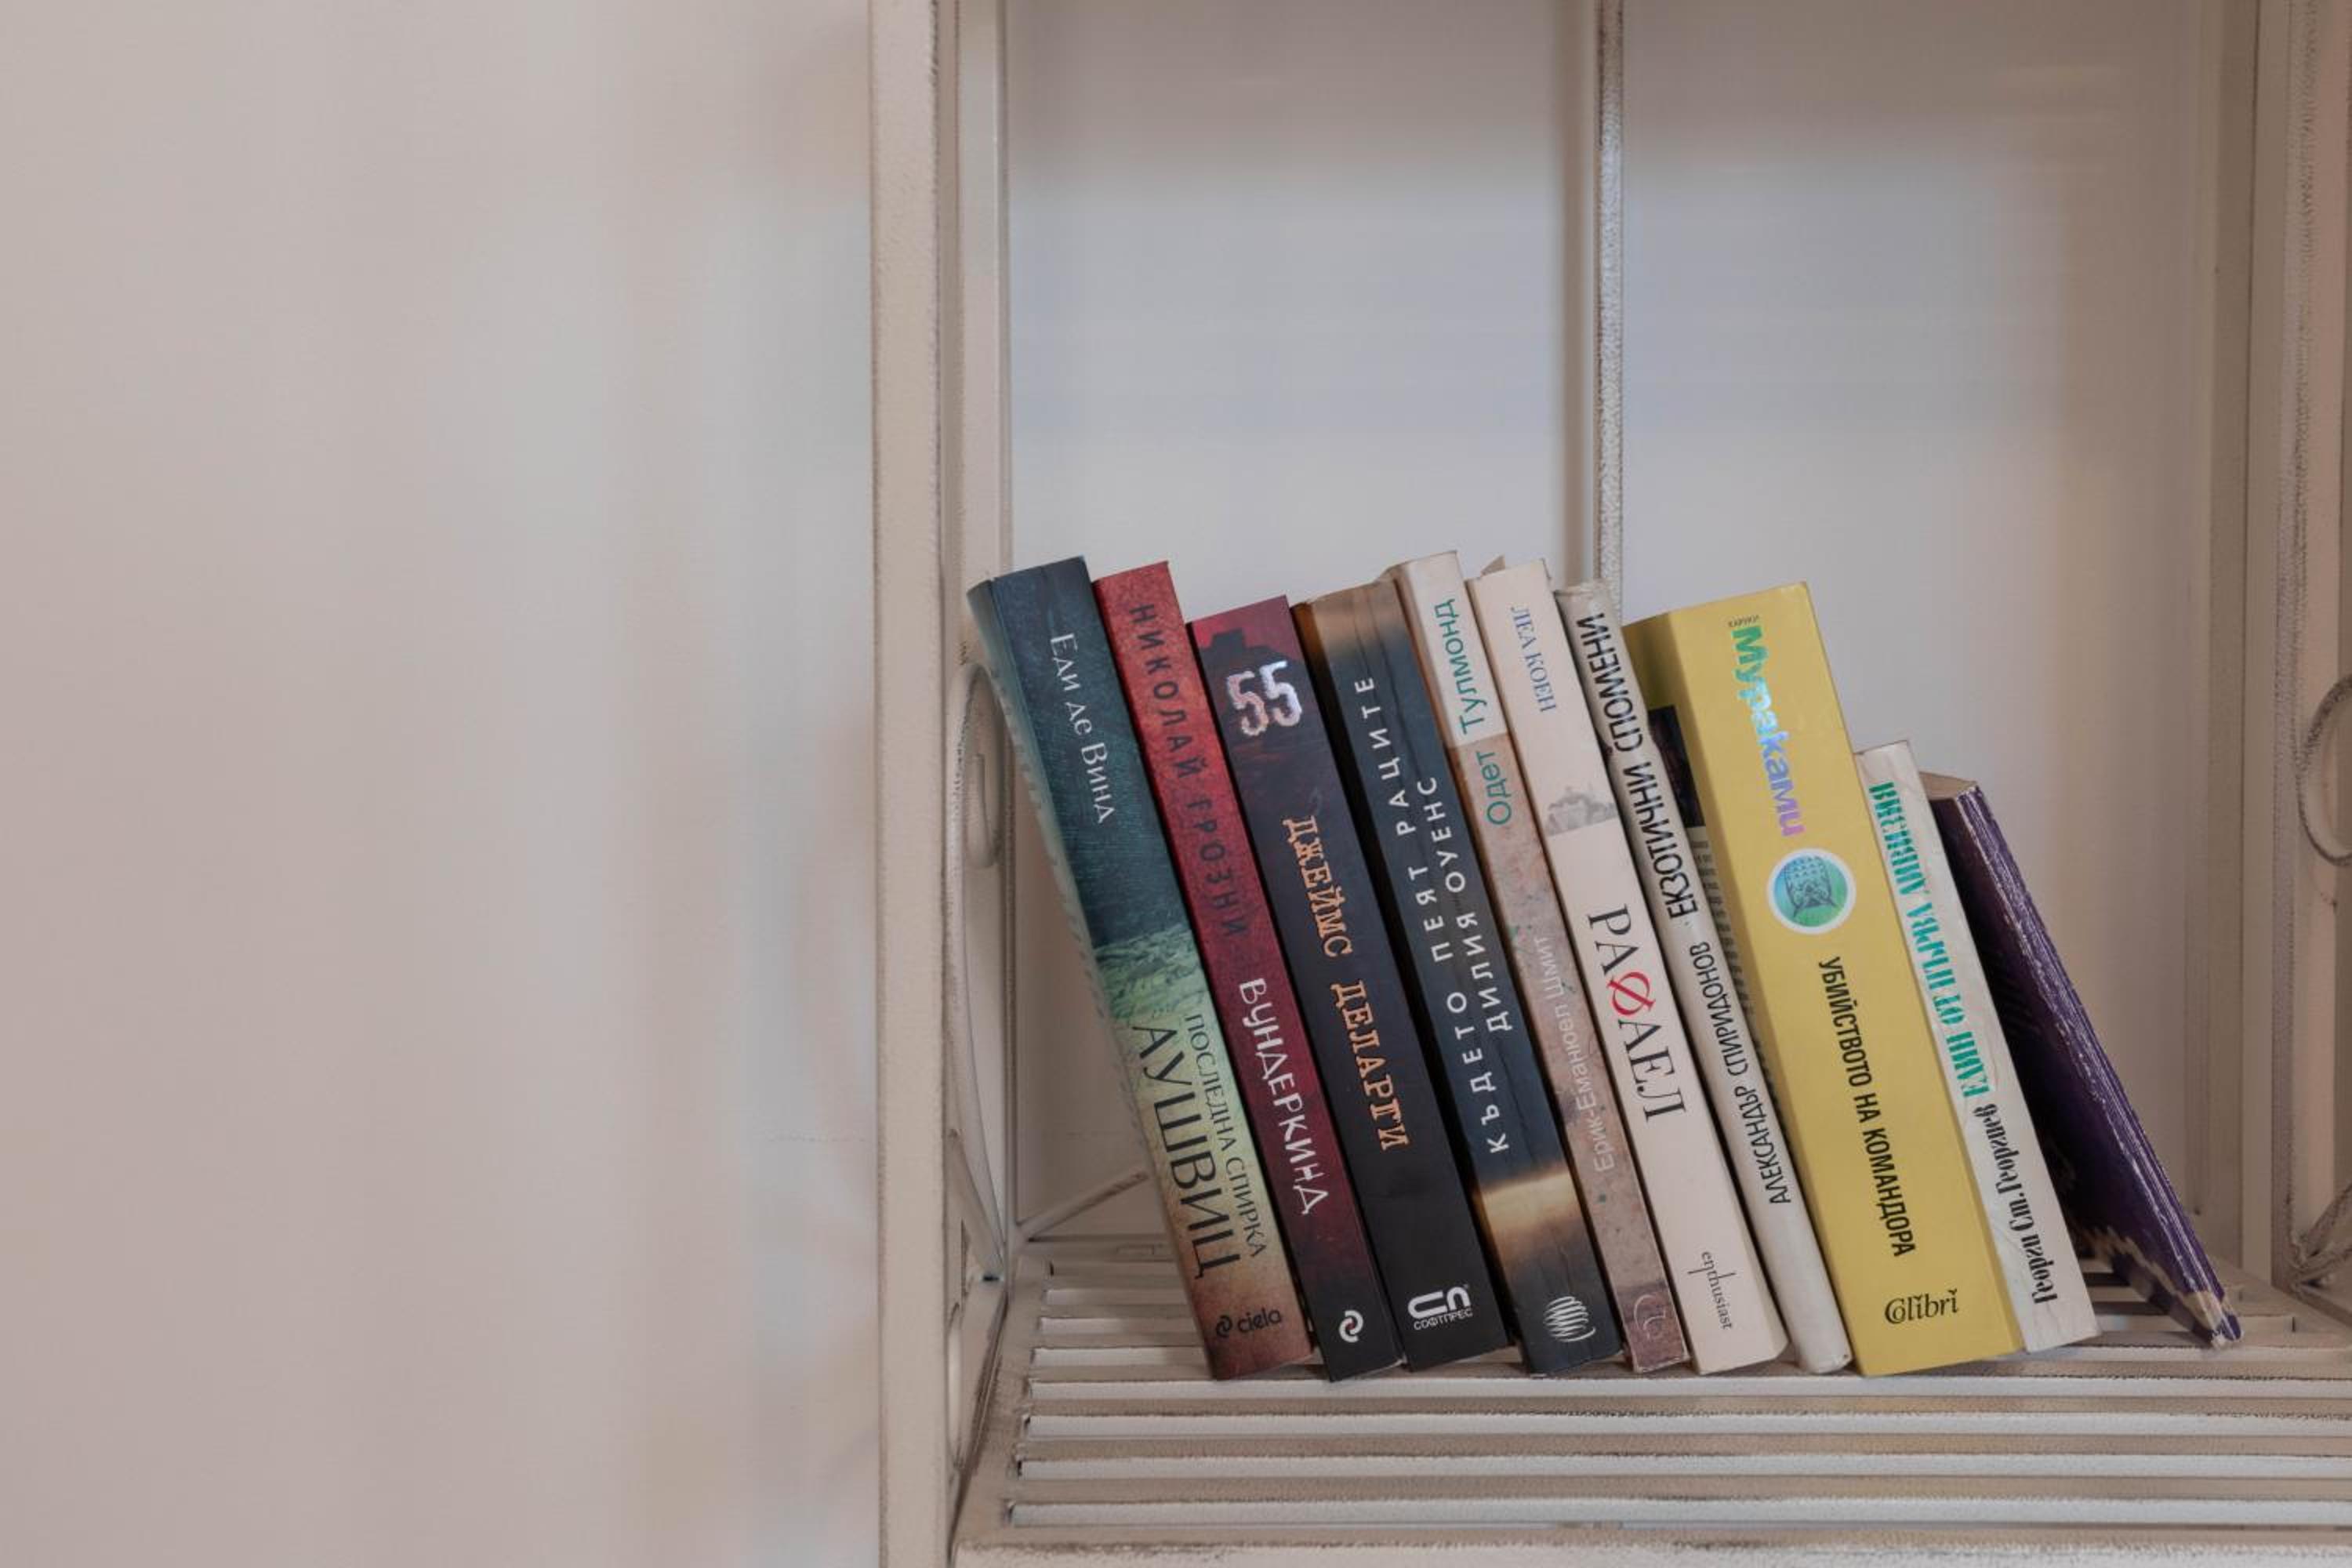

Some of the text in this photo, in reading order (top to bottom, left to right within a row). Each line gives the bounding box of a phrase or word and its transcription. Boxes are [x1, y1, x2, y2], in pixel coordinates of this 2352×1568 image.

[1050, 633, 1115, 823] Еди де Винд
[1129, 603, 1247, 935] НИКОЛАЙ ГРОЗНИ
[1226, 660, 1302, 736] 55
[1435, 598, 1512, 826] Одет Тулмонд
[1511, 606, 1556, 712] ЛЕА КОЕН
[1577, 612, 1697, 919] ЕКЗОТИЧНИ СПОМЕНИ
[1731, 625, 1806, 837] Мураками
[1283, 815, 1410, 1151] ДЖЕЙМС ДЕЛАРГИ
[1355, 677, 1510, 1153] КЪДЕТО ПЕЯТ РАЦИТЕ
[1417, 778, 1513, 1031] ДИЛИЯ ОУЕНС
[1588, 903, 1686, 1123] РАФАЕЛ
[1690, 941, 1748, 1076] СПИРИДОНОВ
[1869, 781, 1990, 1098] ЕДИН ОТ ПЪРВА ДИВИЗИЯ
[1133, 1025, 1240, 1279] АУШВИЦ
[1185, 1013, 1266, 1257] ПОСЛЕДНА СПИРКА
[1239, 978, 1328, 1215] ВУНДЕРКИНД
[1536, 937, 1614, 1172] Ерик-Еманюел Шмит
[1728, 1086, 1791, 1205] АЛЕКСАНДЪР
[1819, 956, 1915, 1257] УБИЙСТВОТО НА КОМАНДОРА
[1973, 1103, 2023, 1195] Георгиев
[1238, 1308, 1283, 1334] cielo
[1414, 1308, 1473, 1330] СОФТПРЕС
[1687, 1251, 1737, 1330] enthusiast
[1884, 1288, 1959, 1324] Colibri
[2022, 1233, 2058, 1304] Георги
